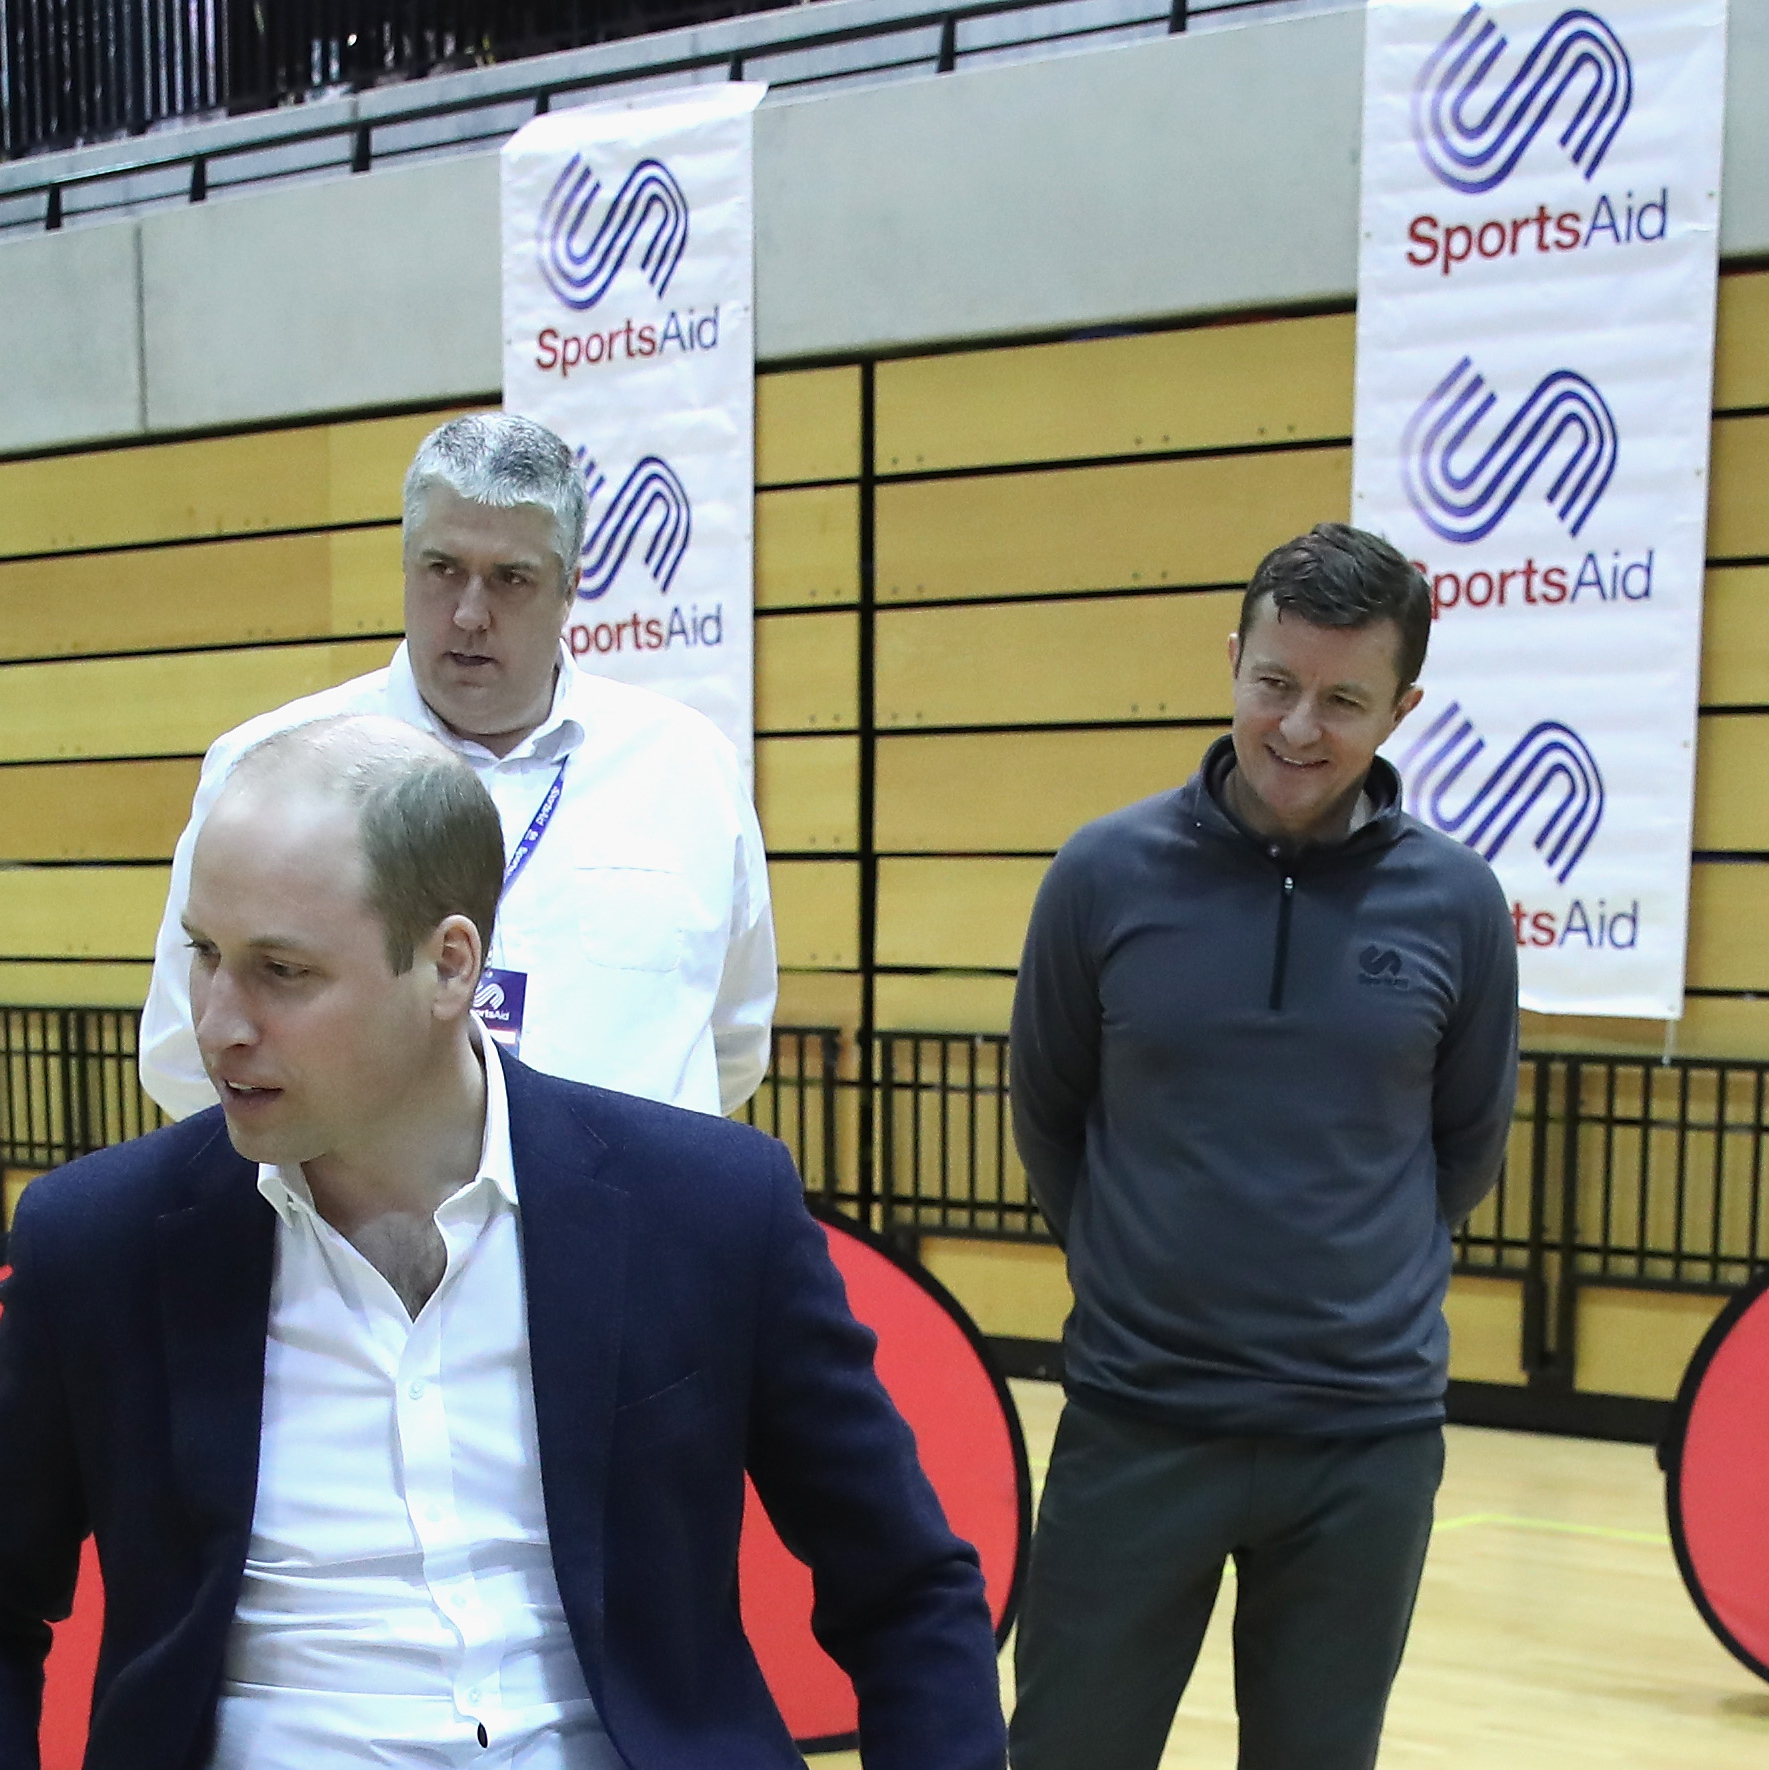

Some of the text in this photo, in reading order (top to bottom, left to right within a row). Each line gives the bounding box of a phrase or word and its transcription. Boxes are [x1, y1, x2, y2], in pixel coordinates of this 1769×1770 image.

[1405, 189, 1668, 277] SportsAid
[535, 306, 720, 378] SportsAid
[1410, 549, 1654, 621] portsAid
[568, 603, 723, 655] portsAid
[1509, 899, 1638, 950] tsAid
